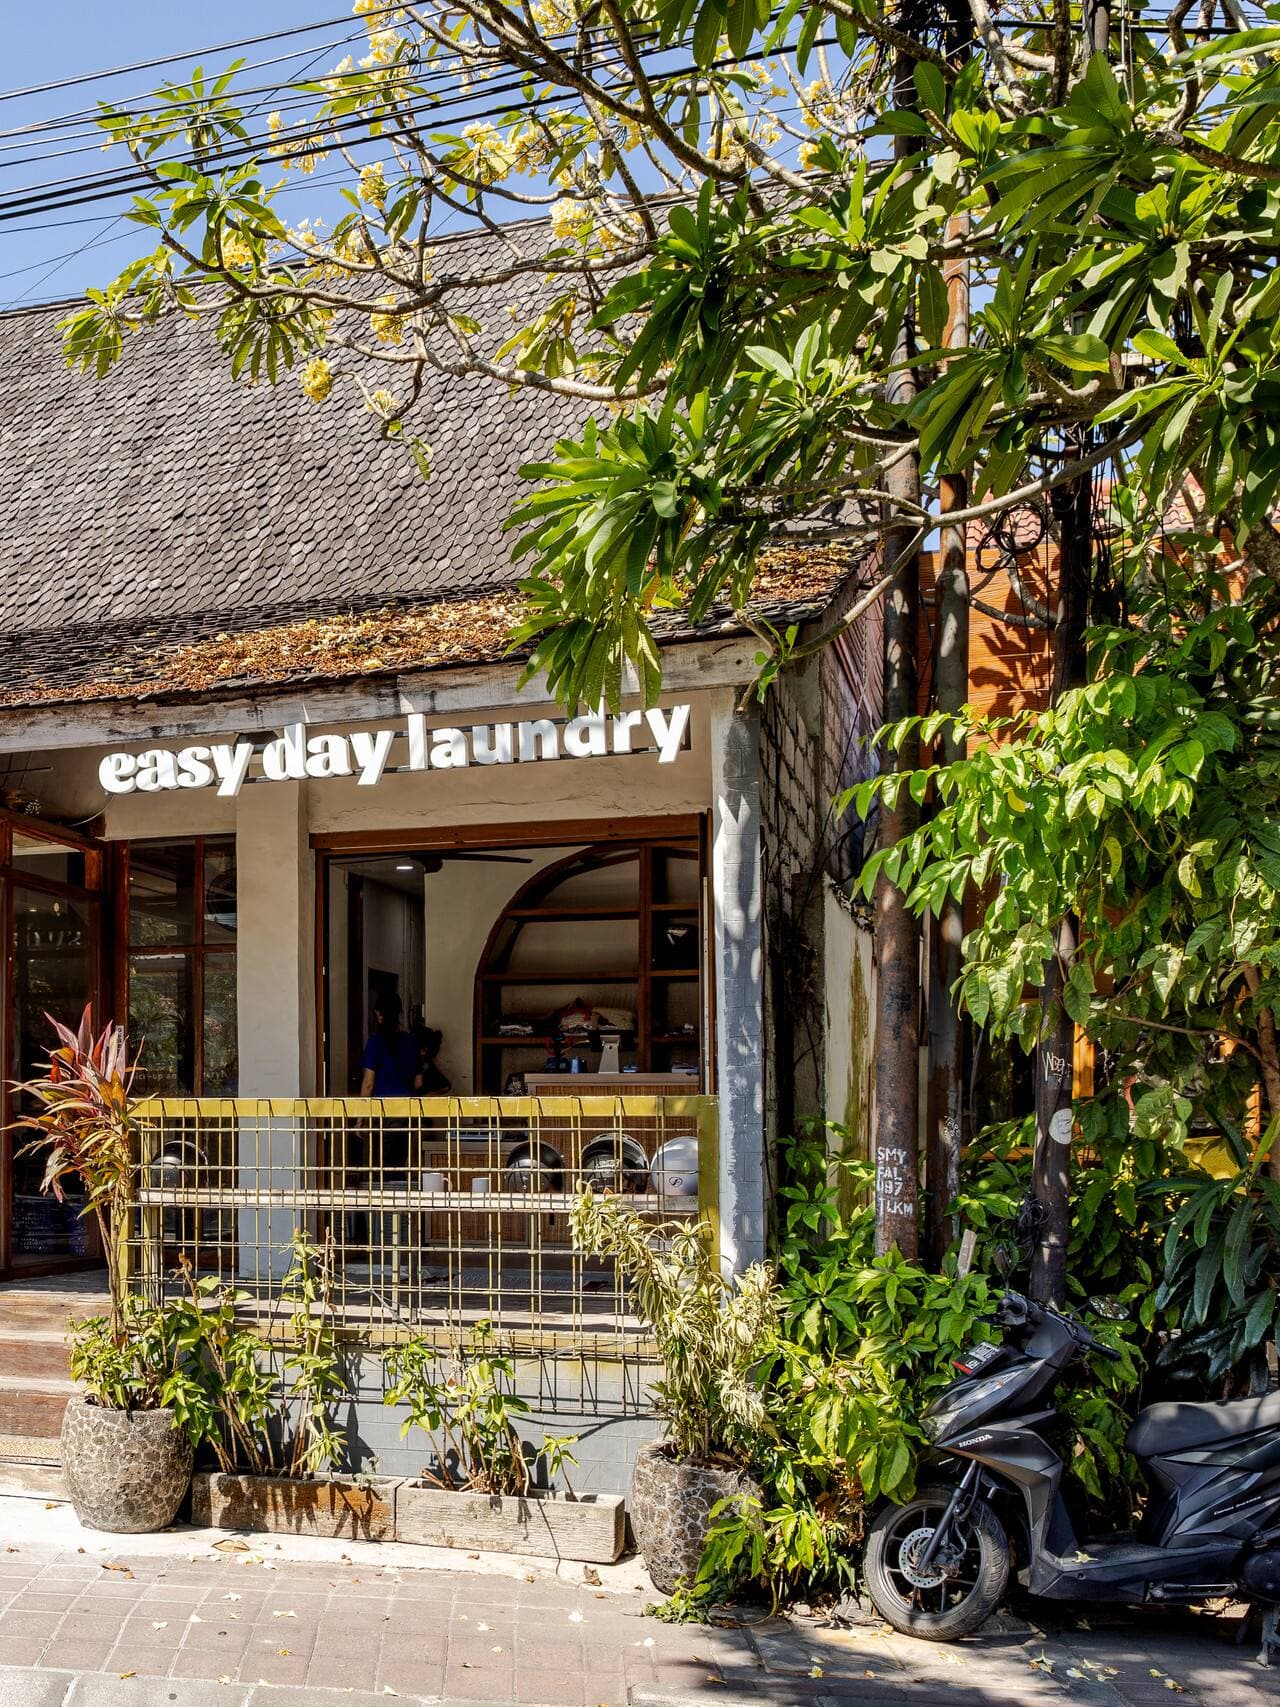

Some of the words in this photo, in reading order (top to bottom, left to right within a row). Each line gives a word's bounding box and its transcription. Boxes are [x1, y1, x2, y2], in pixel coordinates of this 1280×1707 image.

[98, 741, 254, 797] easy
[262, 722, 395, 785] day
[407, 697, 691, 771] laundry
[877, 1147, 907, 1164] SMY
[959, 1434, 993, 1448] HONDA
